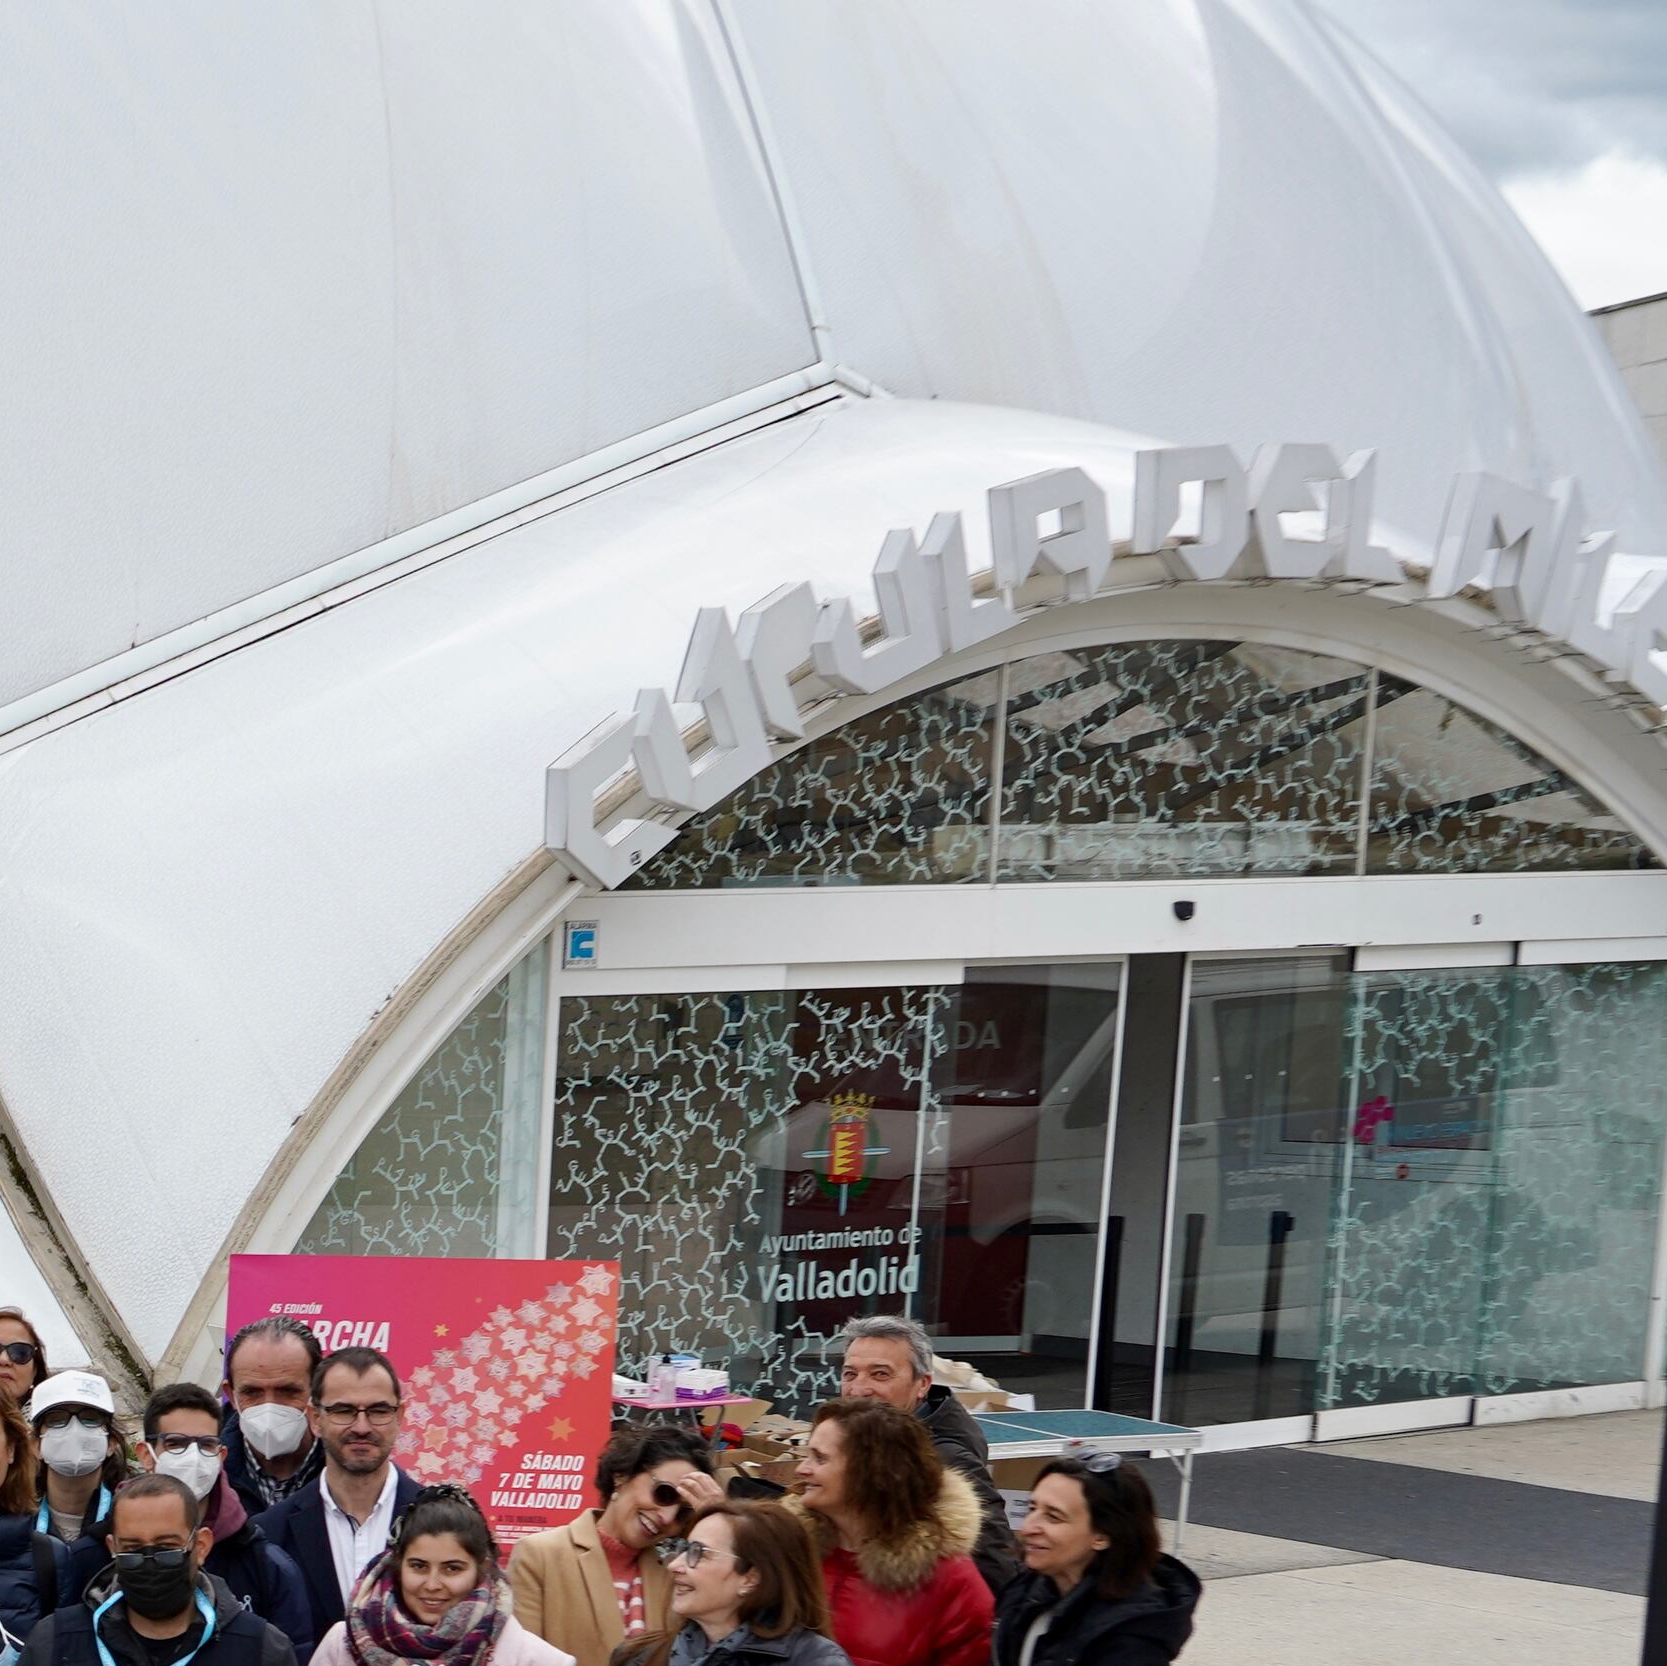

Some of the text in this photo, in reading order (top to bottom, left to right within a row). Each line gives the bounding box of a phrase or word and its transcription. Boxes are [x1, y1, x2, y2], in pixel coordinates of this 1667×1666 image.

[1132, 442, 1407, 581] DEL
[758, 1223, 923, 1258] Ayuntamiento de
[757, 1254, 921, 1303] Valladolid
[269, 1302, 323, 1314] 45 EDICIÓN
[299, 1320, 390, 1353] RCHA
[521, 1450, 585, 1471] SÁBADO
[499, 1473, 584, 1490] 7 DE MAYO
[490, 1491, 583, 1509] VALLADOLID
